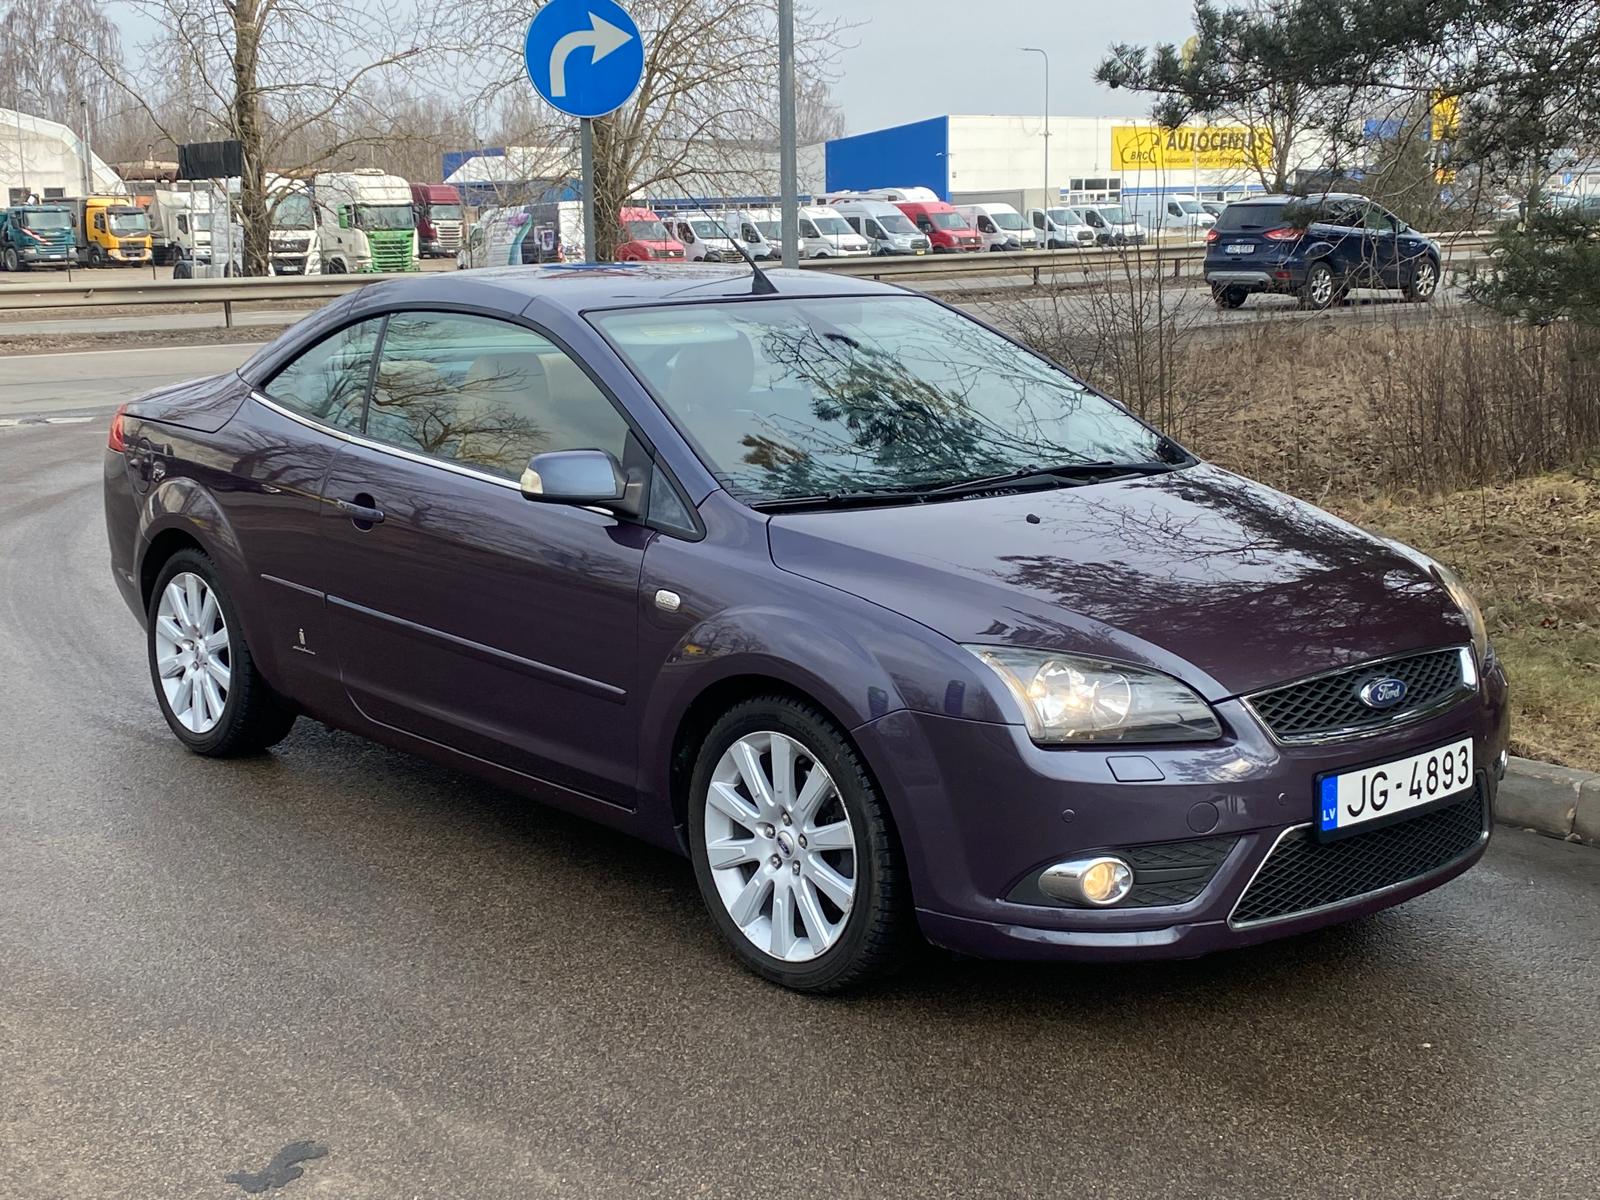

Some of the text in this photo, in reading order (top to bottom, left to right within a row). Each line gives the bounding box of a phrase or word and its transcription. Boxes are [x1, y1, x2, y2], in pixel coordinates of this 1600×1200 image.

[1377, 682, 1400, 701] Ford
[1347, 745, 1469, 817] JG-4893
[1322, 807, 1337, 821] LV
